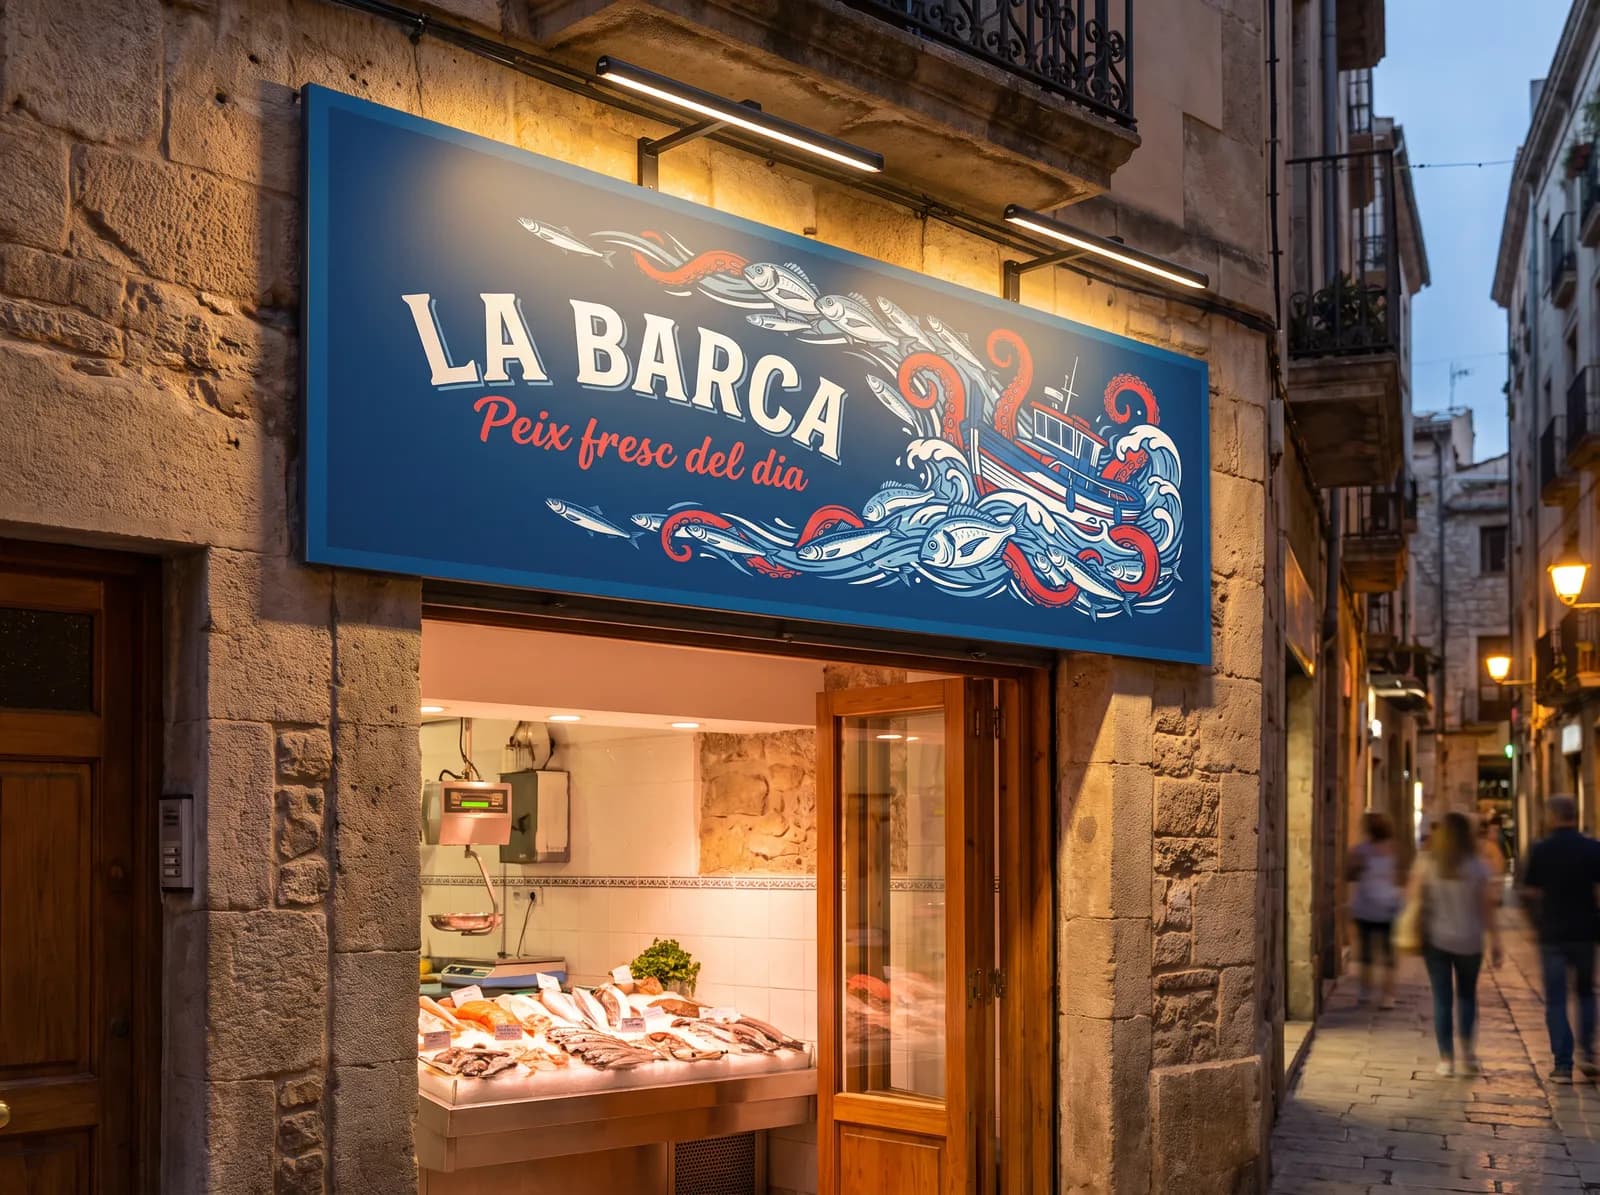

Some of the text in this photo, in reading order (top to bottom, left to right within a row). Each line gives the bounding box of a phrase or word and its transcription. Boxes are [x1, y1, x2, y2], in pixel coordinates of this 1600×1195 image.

[401, 293, 846, 462] LA BARCA
[473, 395, 809, 492] Peix fresc del dia
